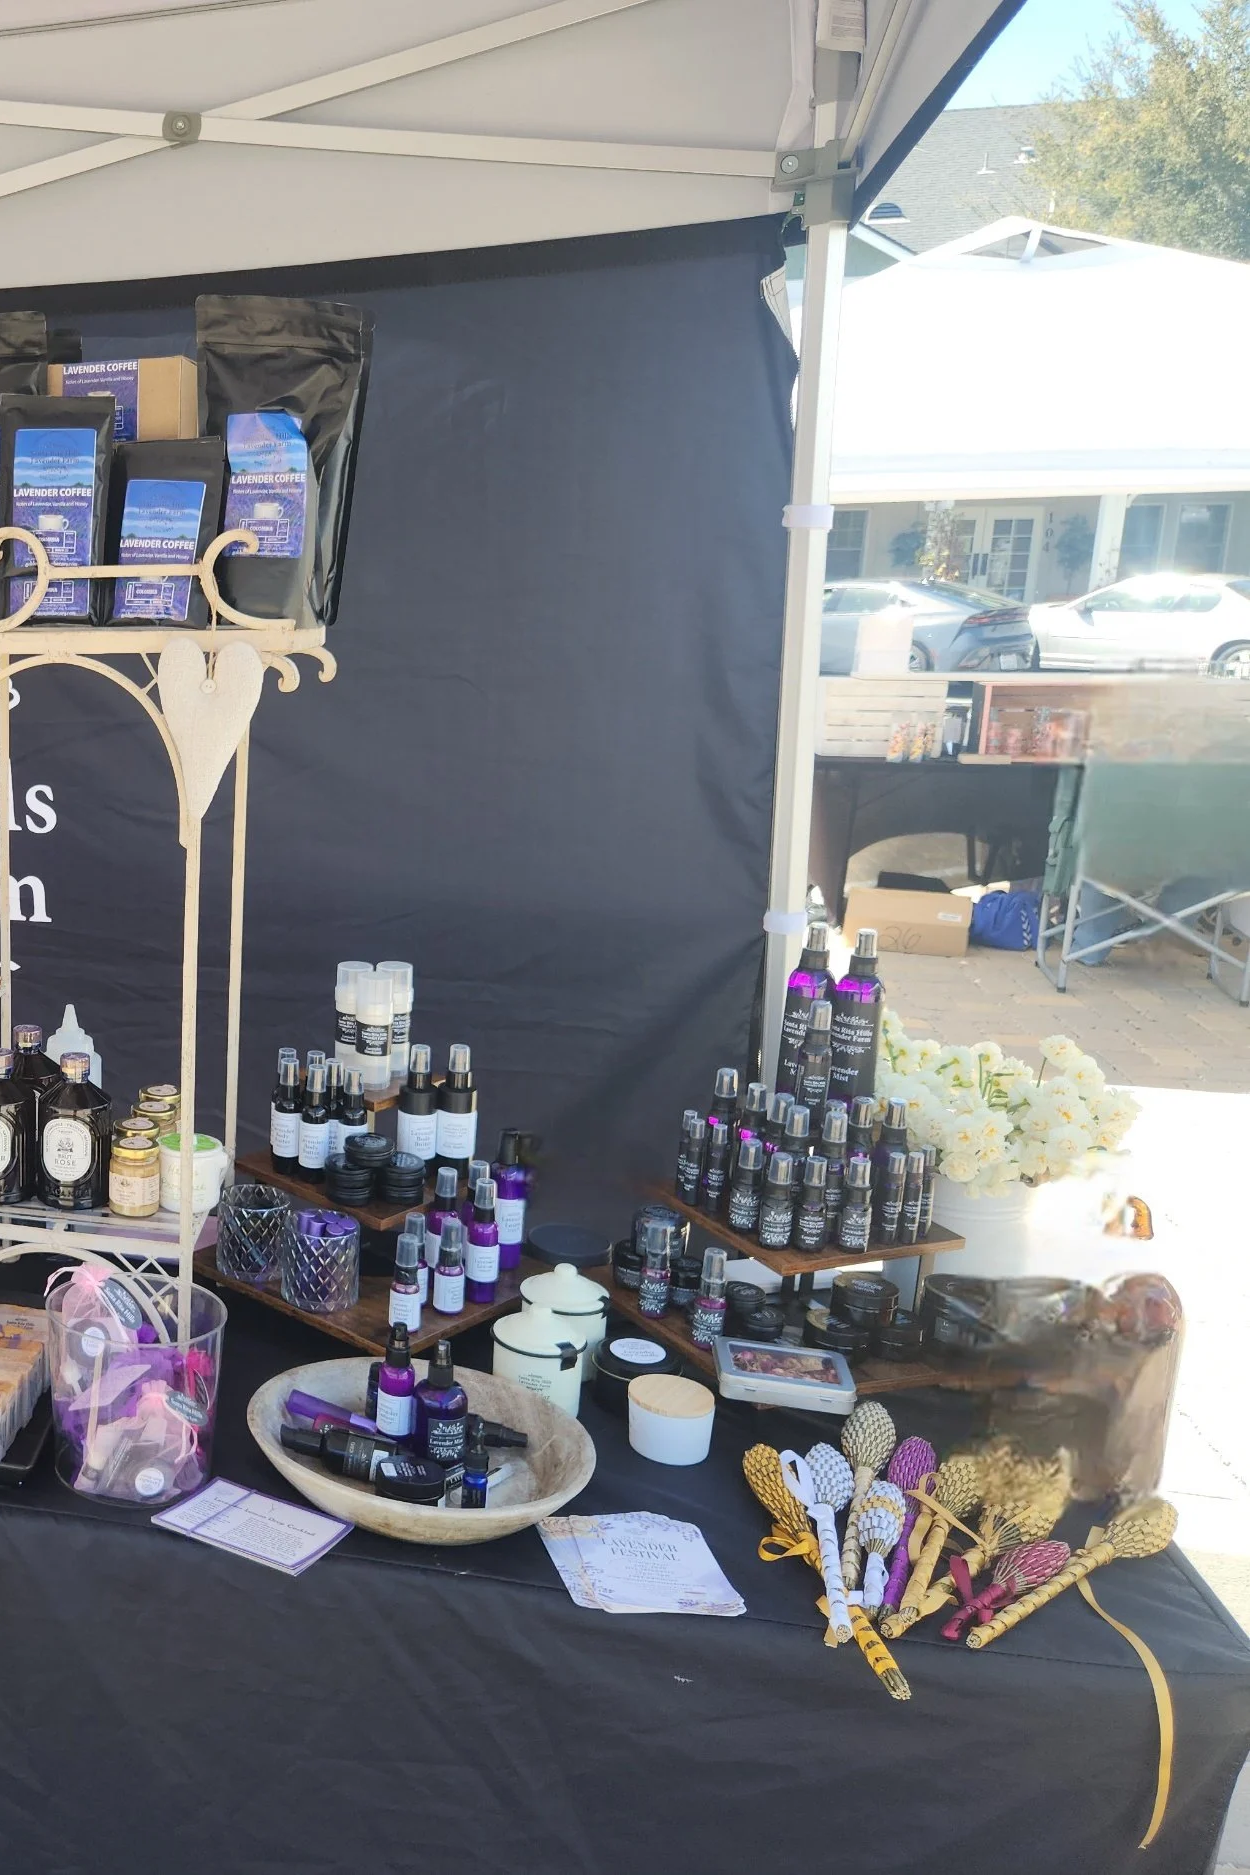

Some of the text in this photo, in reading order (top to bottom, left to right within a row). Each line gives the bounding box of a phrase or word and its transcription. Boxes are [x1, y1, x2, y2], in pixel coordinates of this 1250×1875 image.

[63, 361, 138, 375] LAVENDER COFFEE
[232, 473, 306, 484] LAVENDER COFFEE
[13, 488, 92, 498] LAVENDER COFFEE
[120, 539, 195, 550] LAVENDER COFFEE
[429, 1438, 453, 1446] Lavender
[601, 1537, 679, 1553] LAVENDER
[610, 1547, 681, 1561] FESTIVAL
